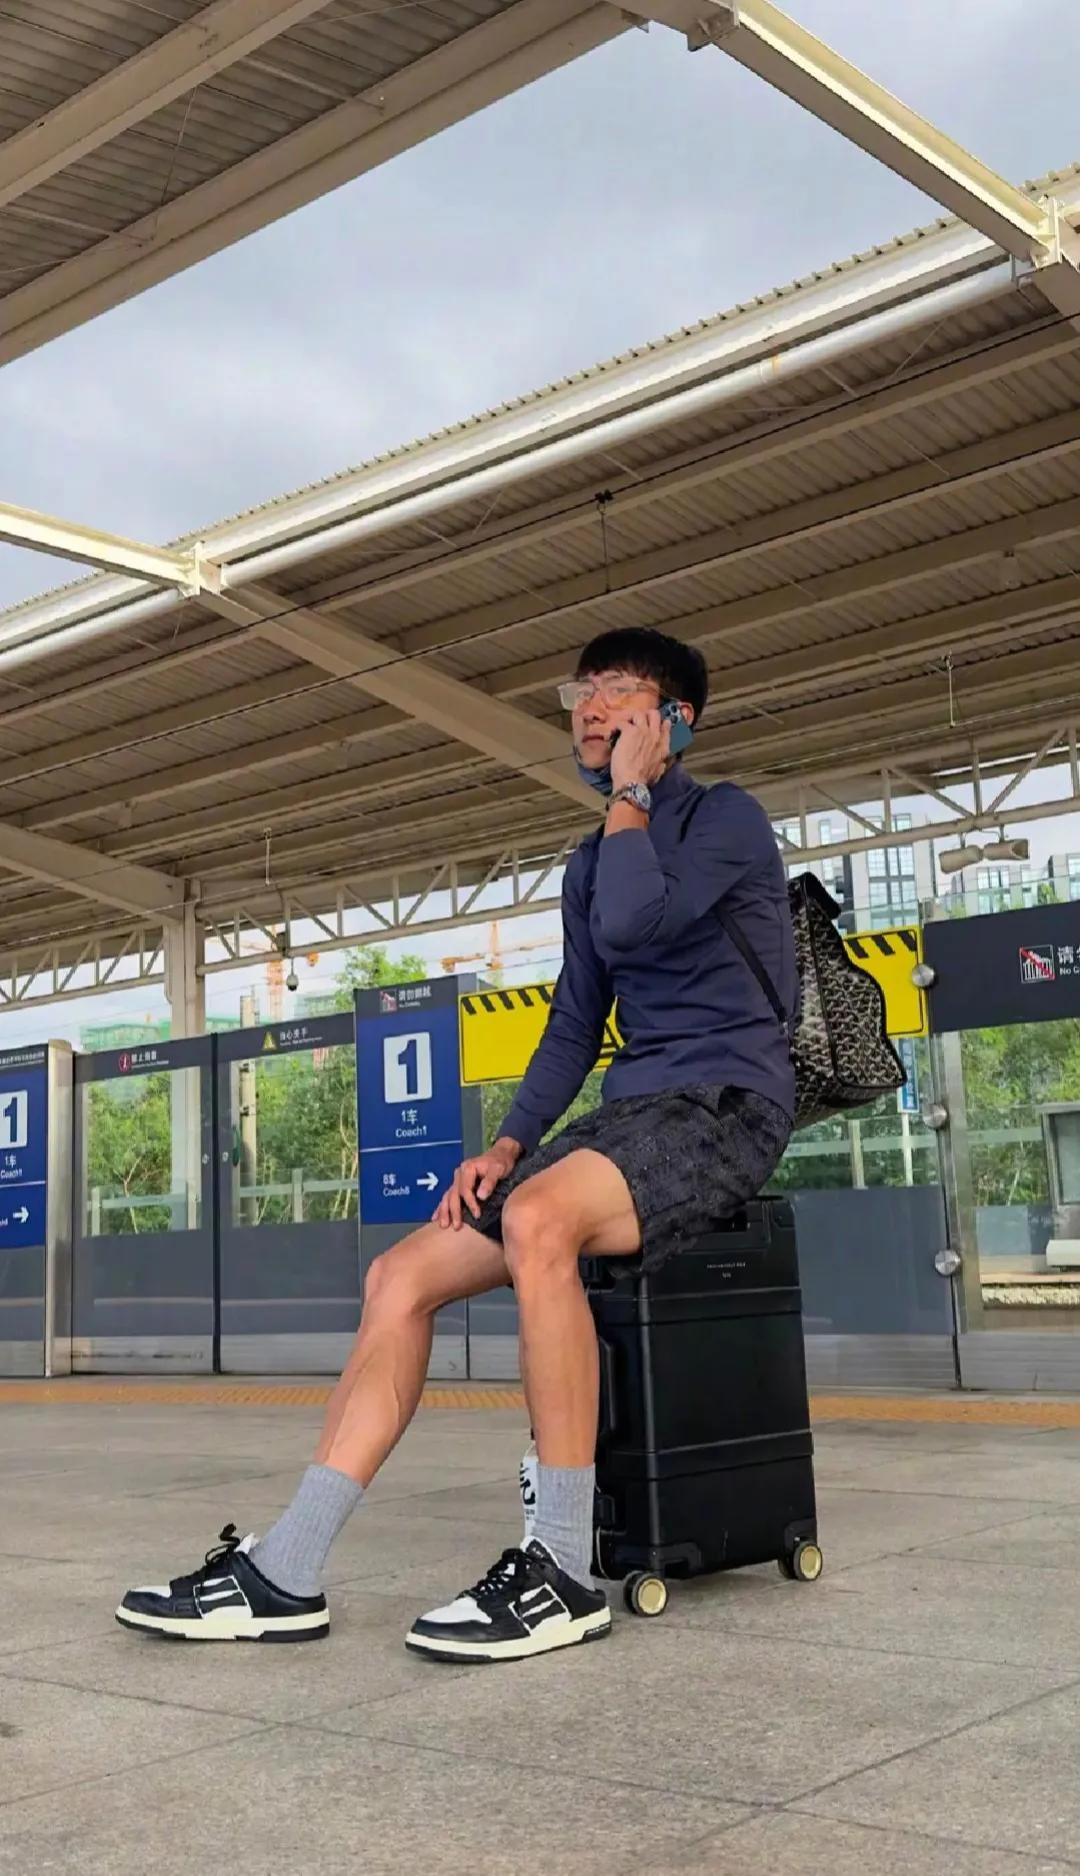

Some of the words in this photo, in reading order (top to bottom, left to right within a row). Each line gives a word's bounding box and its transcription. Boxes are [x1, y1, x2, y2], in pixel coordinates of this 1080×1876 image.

[1060, 967, 1071, 975] No
[398, 1039, 417, 1095] 1
[4, 1096, 17, 1142] 1
[401, 1108, 418, 1125] 1车
[395, 1125, 427, 1138] Coach1
